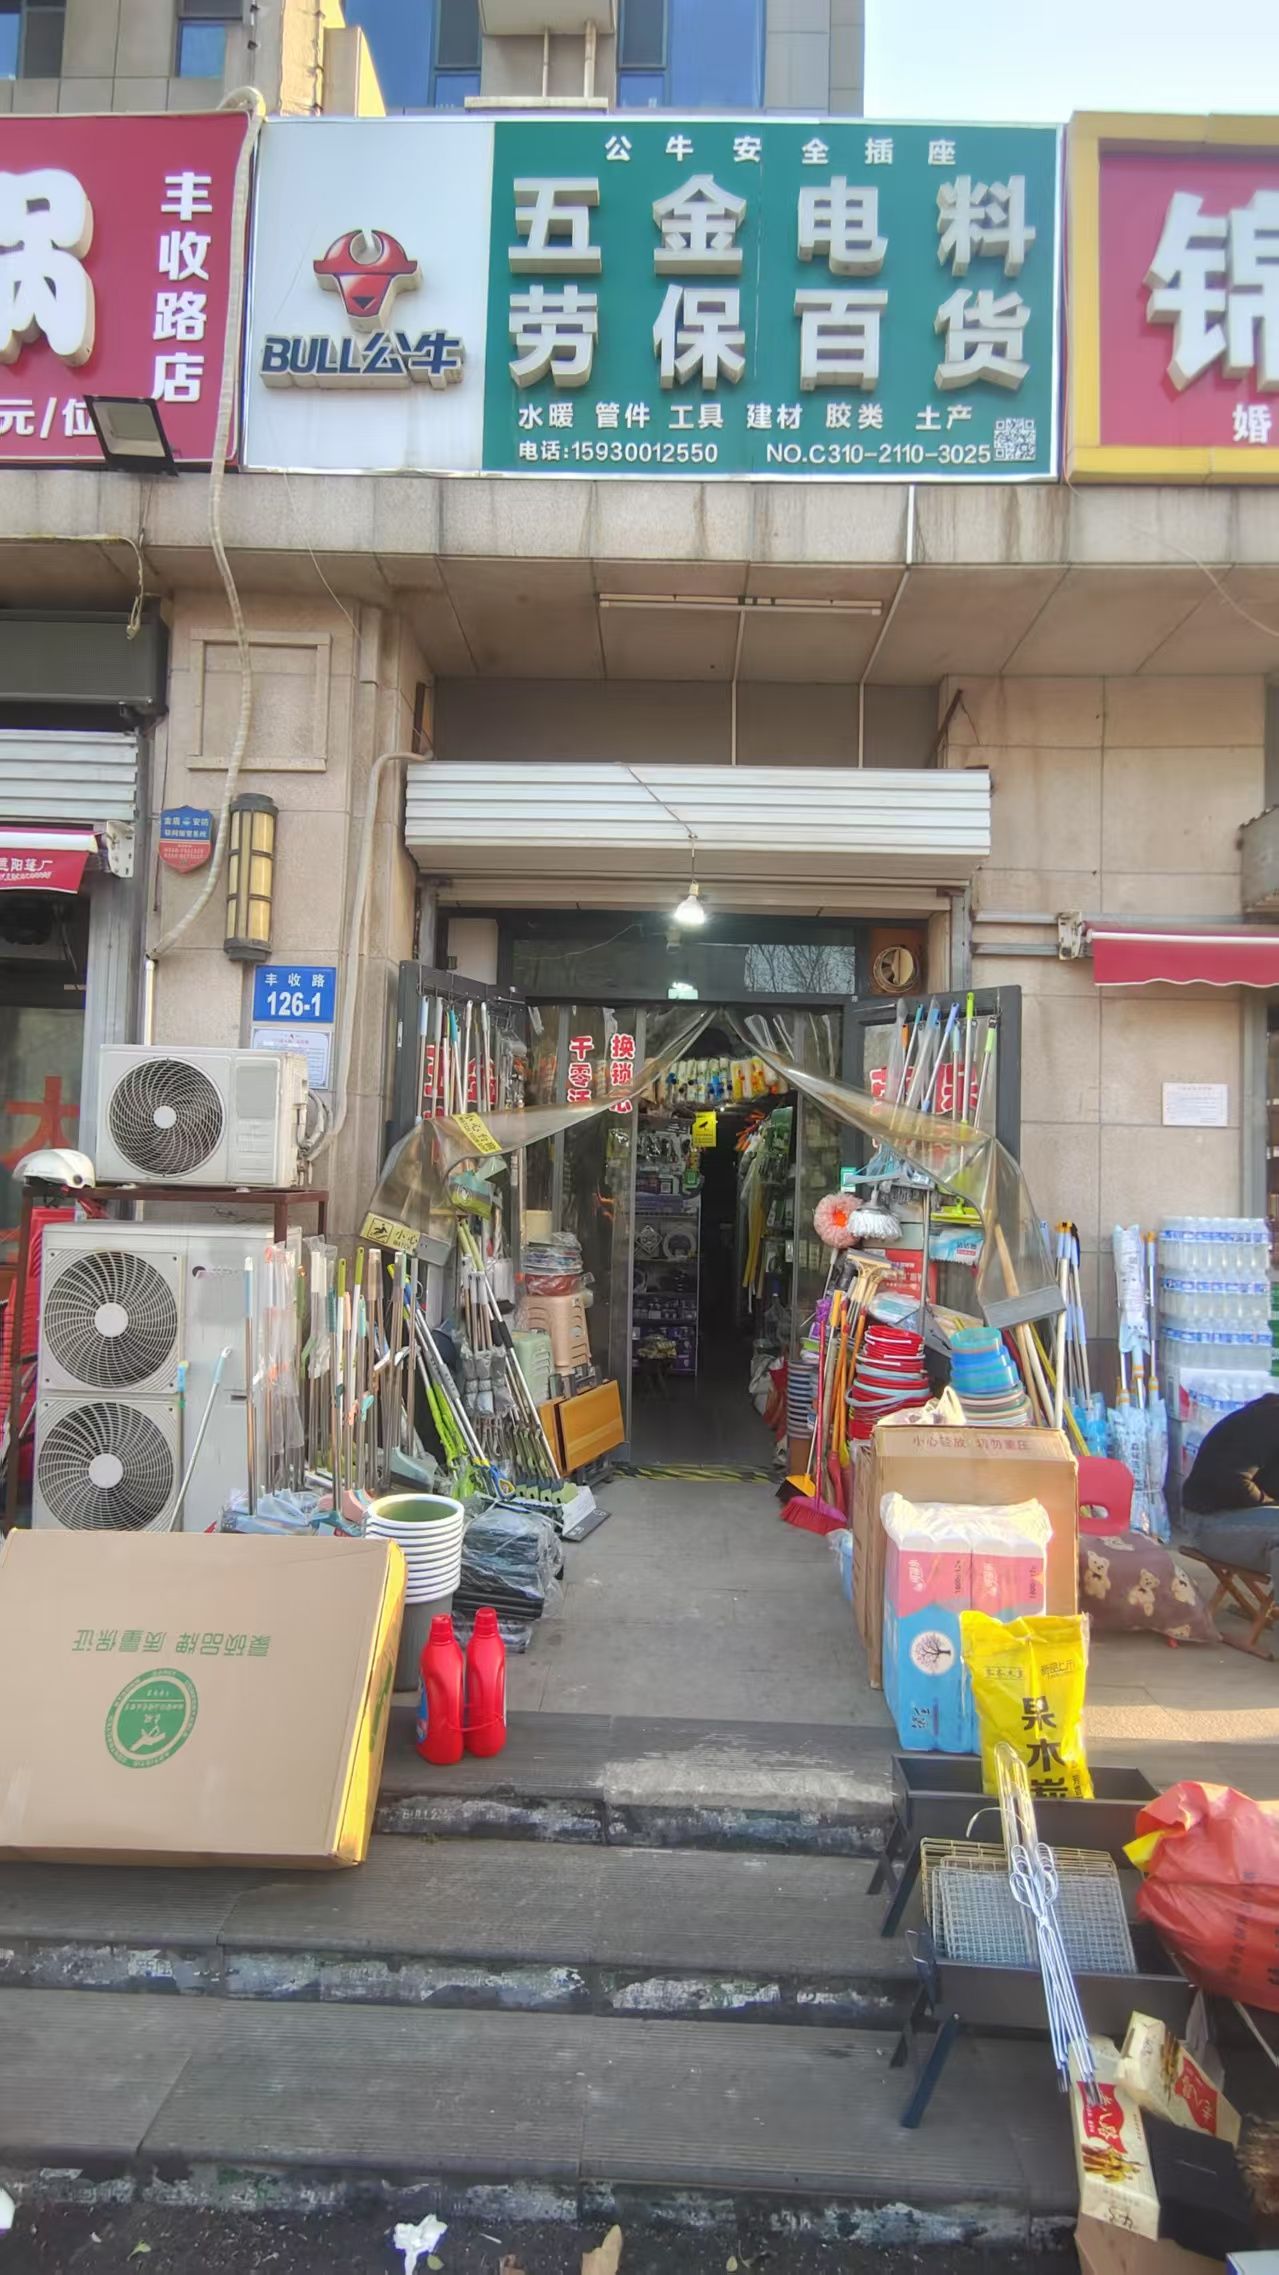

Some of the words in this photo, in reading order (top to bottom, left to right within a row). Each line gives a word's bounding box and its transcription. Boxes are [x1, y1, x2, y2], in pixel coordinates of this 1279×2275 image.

[605, 136, 957, 166] 公牛安全插座
[508, 173, 1036, 277] 五金电料
[152, 171, 213, 403] 丰收路店
[508, 284, 1031, 390] 劳保百货
[518, 402, 573, 430] 水暖
[595, 401, 651, 430] 管件
[668, 403, 724, 430] 工具
[746, 402, 803, 430] 建材
[826, 403, 884, 431] 胶类
[915, 405, 973, 431] 土产
[1231, 403, 1272, 444] 婚
[519, 440, 719, 464] 电话:15930012550
[265, 972, 325, 988] 丰收路
[267, 991, 321, 1017] 126-1
[71, 1629, 168, 1653] 质量保证
